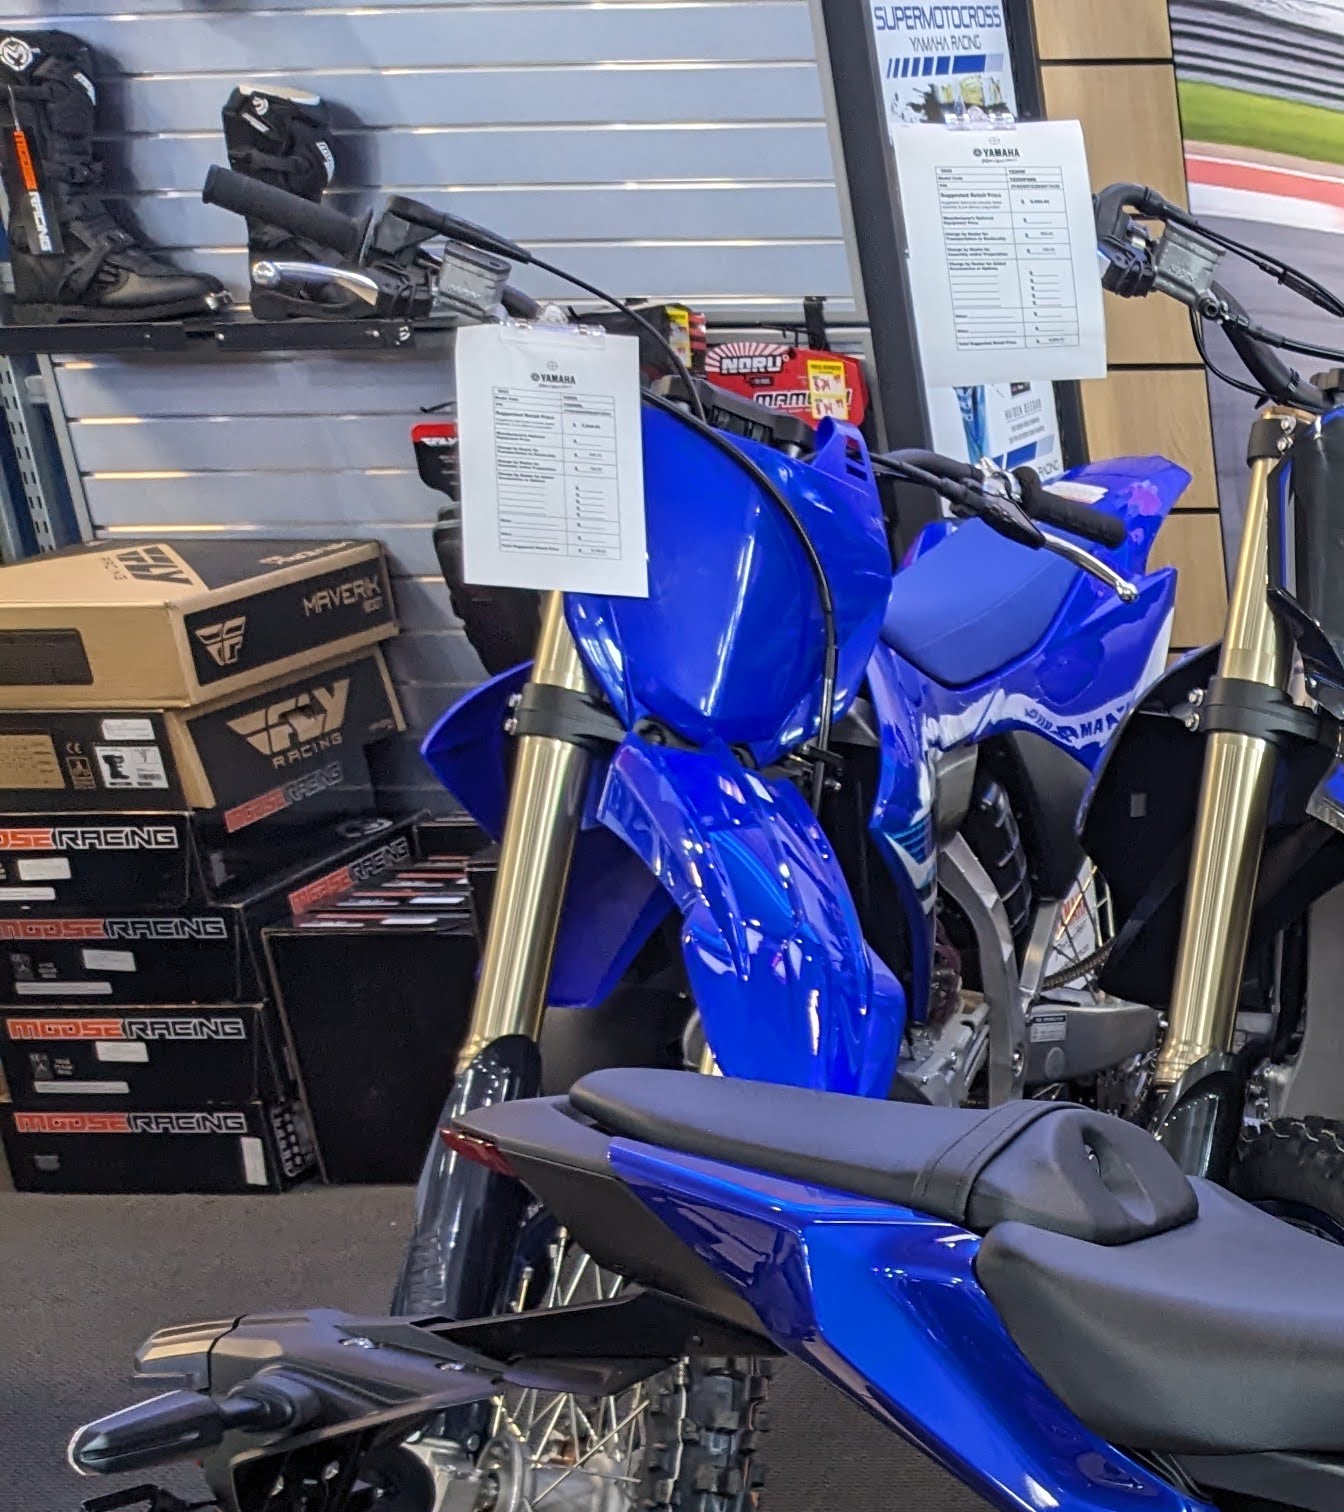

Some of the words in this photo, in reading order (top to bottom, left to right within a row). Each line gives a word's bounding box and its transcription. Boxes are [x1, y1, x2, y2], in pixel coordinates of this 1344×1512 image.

[873, 5, 1002, 31] SUPERMOTOCROSS
[909, 36, 950, 52] YAMAHA
[950, 34, 982, 51] RACING
[982, 148, 1021, 157] YAMAHA
[719, 356, 784, 375] NORU
[540, 373, 576, 384] YAMAHA
[303, 575, 383, 617] MAVERIK
[271, 731, 344, 770] RACING
[0, 827, 57, 850] OSE
[55, 826, 179, 849] RACING
[0, 918, 107, 940] MOOSE
[104, 917, 228, 939] RACING
[6, 1018, 126, 1040] MOOSE
[124, 1018, 246, 1040] RACING
[14, 1111, 132, 1134] MOOSE
[130, 1112, 248, 1134] RACING
